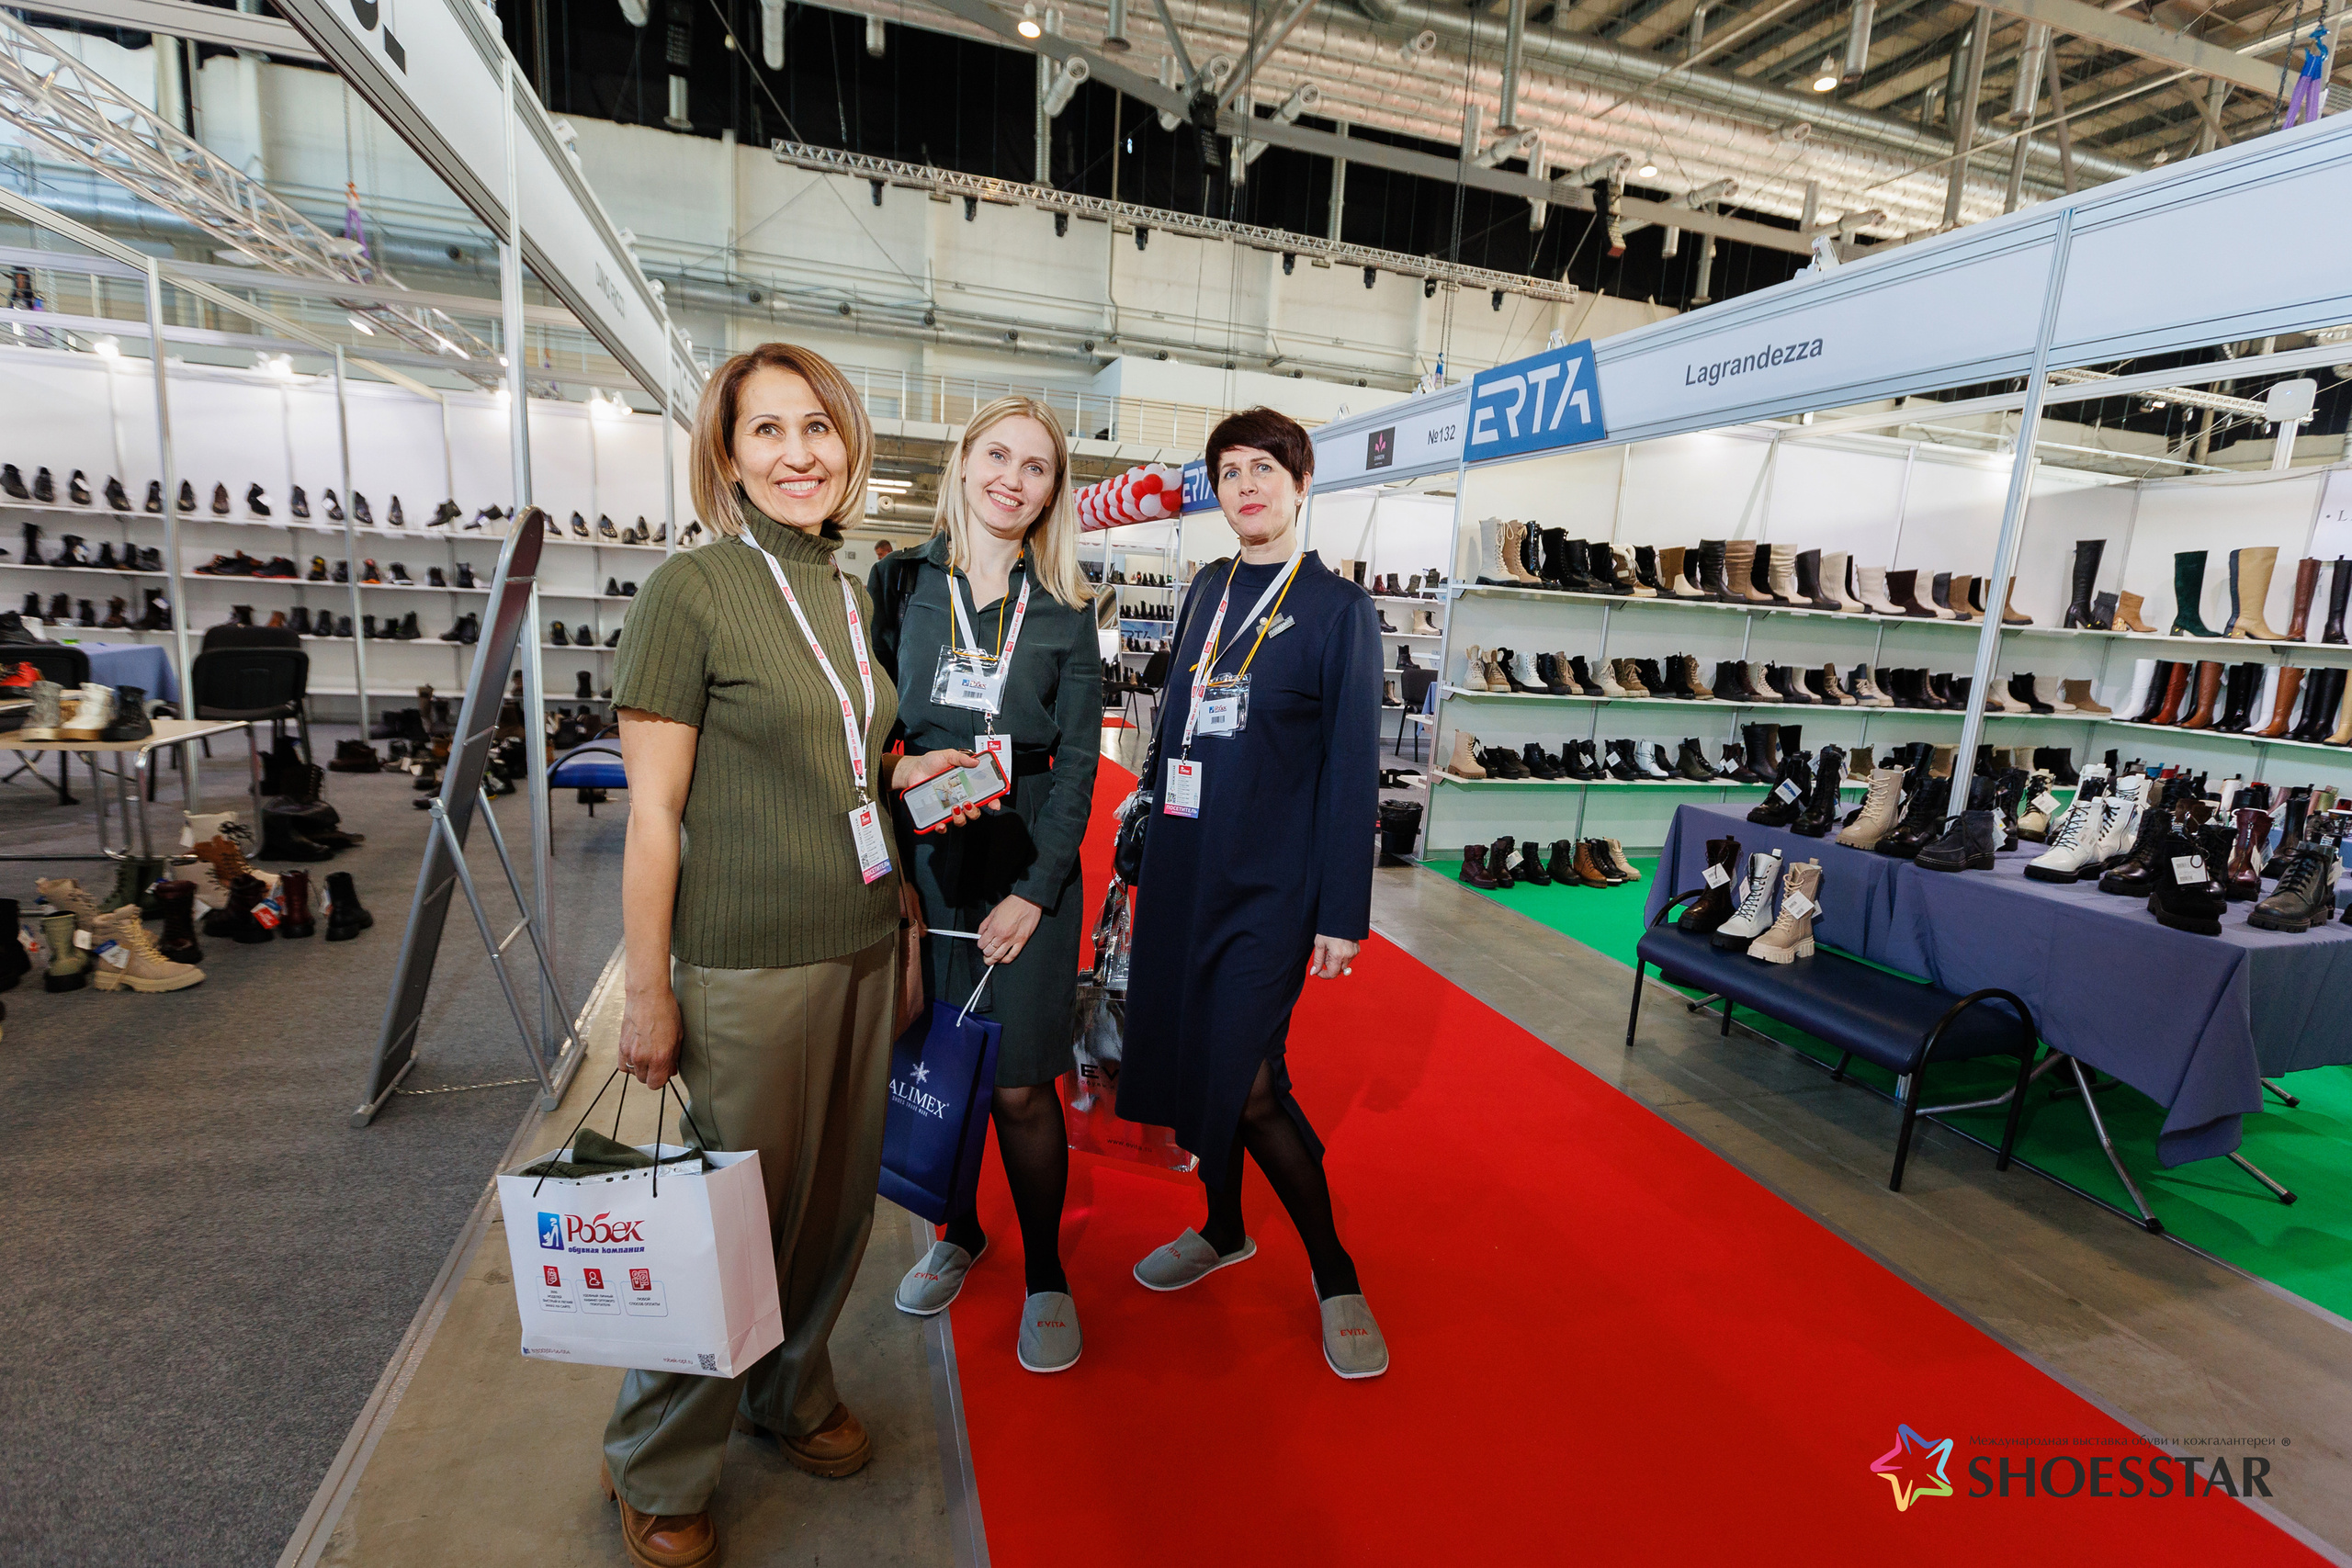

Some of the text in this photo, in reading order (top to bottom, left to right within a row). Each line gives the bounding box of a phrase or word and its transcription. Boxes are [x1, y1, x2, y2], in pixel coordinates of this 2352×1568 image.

[1685, 337, 1824, 386] Lagrandezza
[1471, 355, 1592, 446] ERTA
[1427, 424, 1456, 446] №132
[2337, 510, 2352, 522] L
[1166, 805, 1198, 814] ПОСЕТИТЕЛЬ
[564, 1210, 645, 1243] Робек
[568, 1246, 645, 1255] обувная компания
[1037, 1320, 1067, 1328] EVITA
[1340, 1328, 1368, 1337] EVITA
